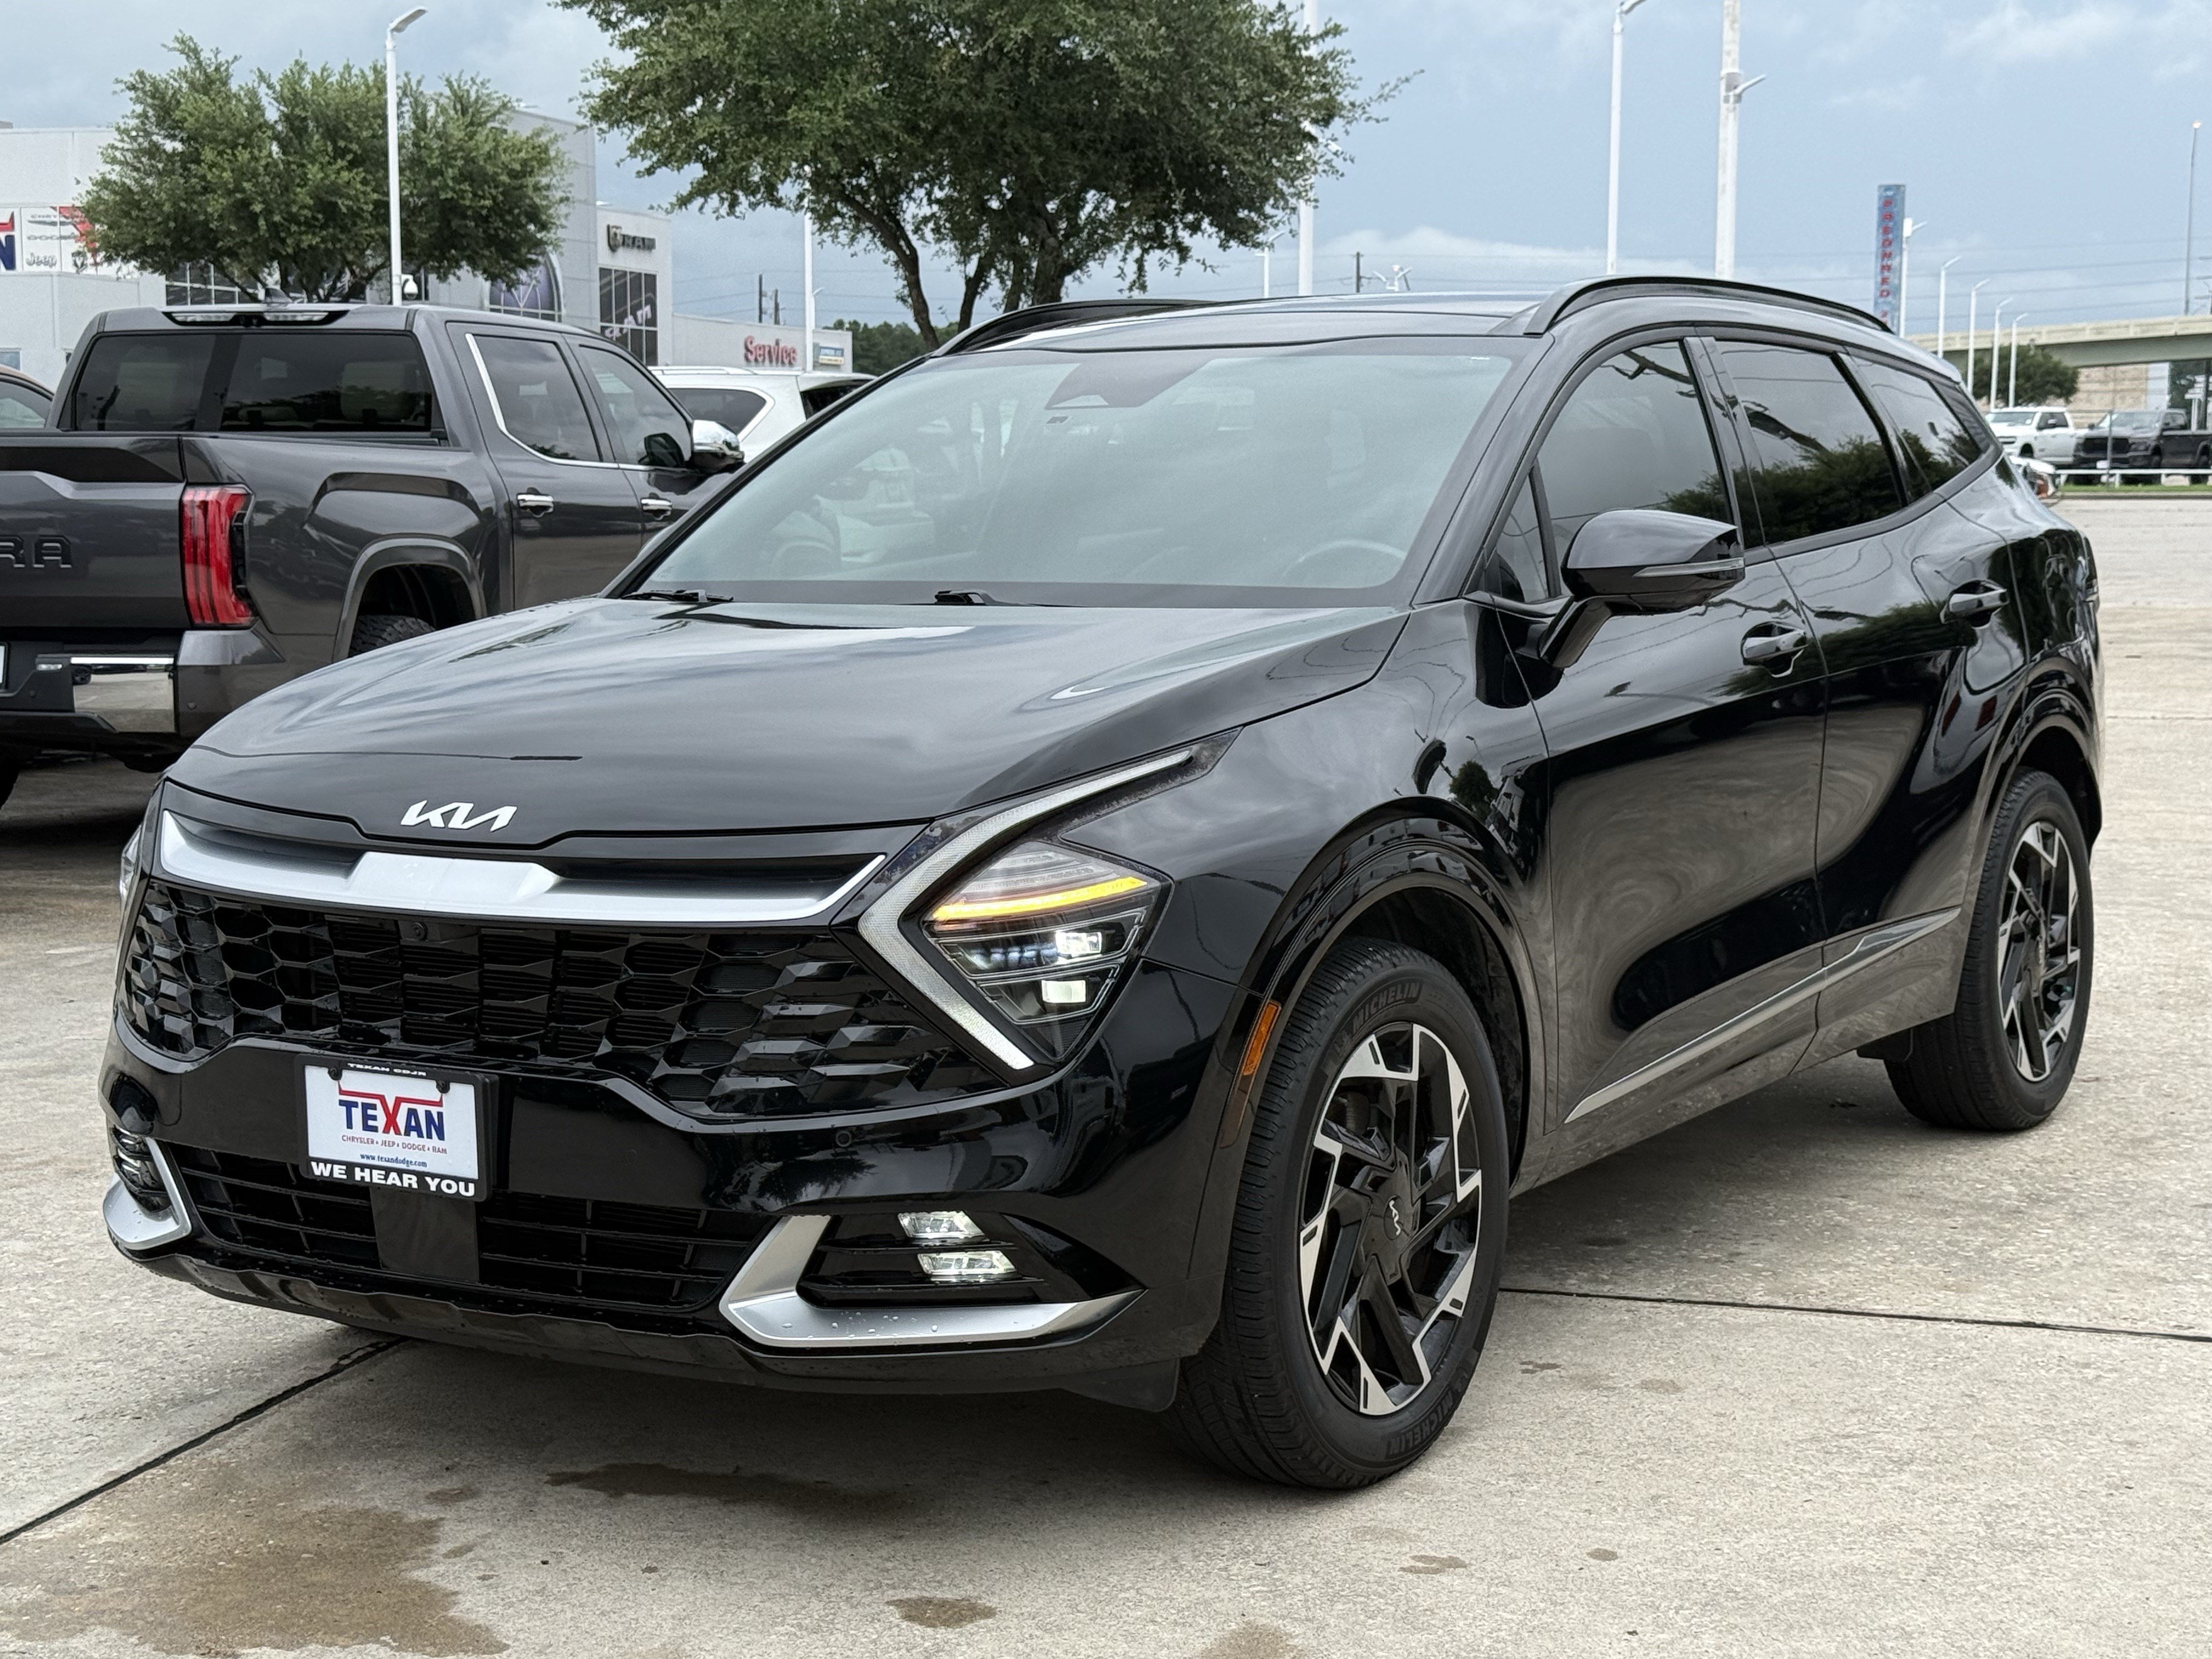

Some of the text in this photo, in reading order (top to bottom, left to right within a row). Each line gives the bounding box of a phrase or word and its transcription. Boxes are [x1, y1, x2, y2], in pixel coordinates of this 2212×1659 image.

[26, 252, 57, 268] Jeep
[744, 335, 797, 365] Service
[401, 799, 517, 833] KIA
[1352, 983, 1420, 1035] MICHELIN
[348, 1063, 390, 1072] TEXAN
[338, 1081, 445, 1141] TEXAN
[342, 1135, 448, 1154] CHRYSLER JEEP DODGE RAM
[311, 1161, 475, 1197] WE HEAR YOU
[1390, 1390, 1454, 1455] MICHELIN
